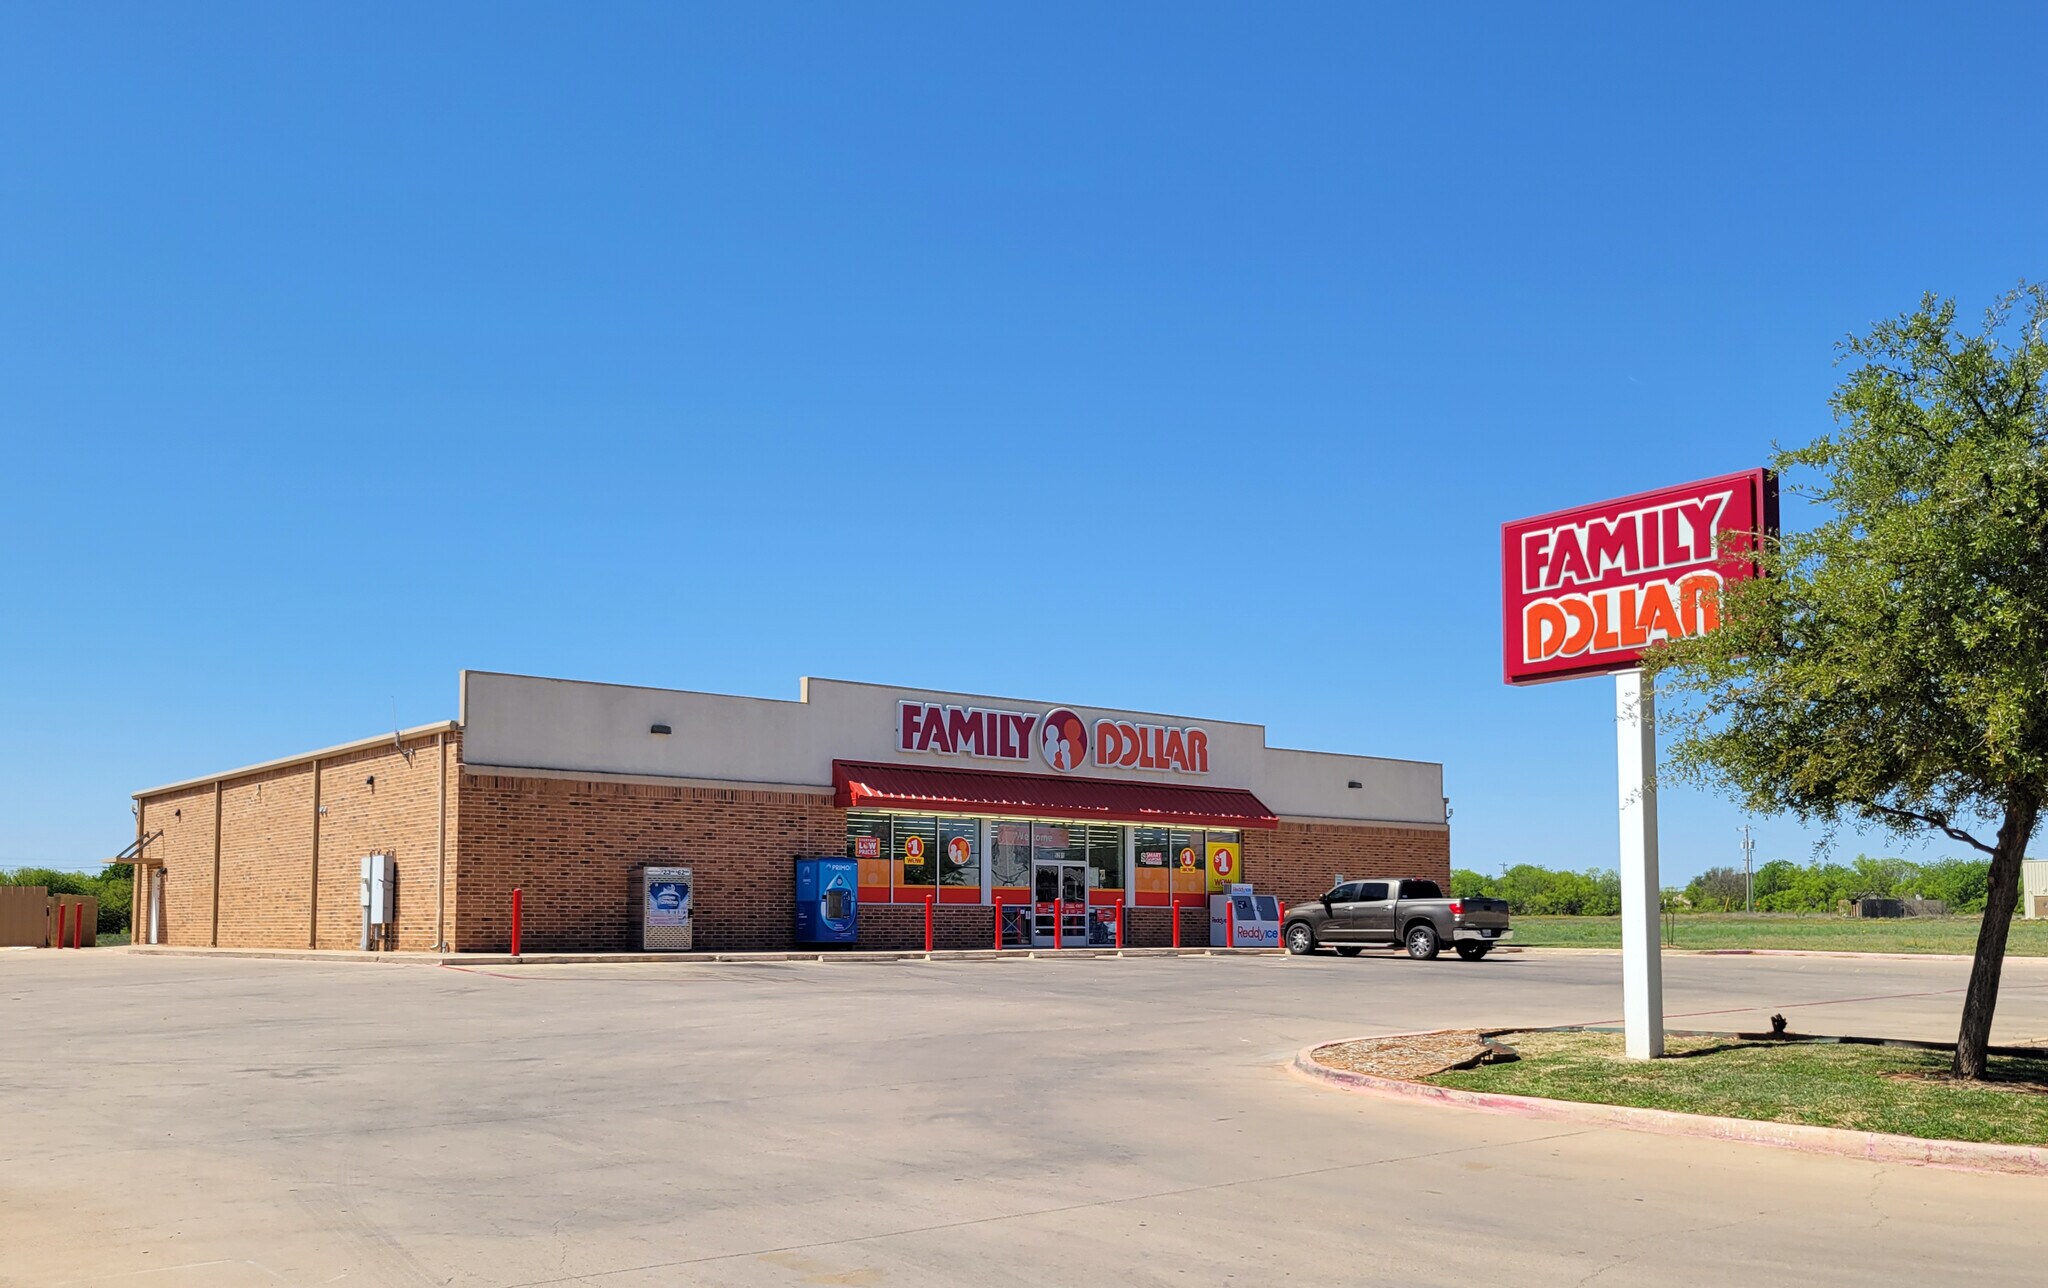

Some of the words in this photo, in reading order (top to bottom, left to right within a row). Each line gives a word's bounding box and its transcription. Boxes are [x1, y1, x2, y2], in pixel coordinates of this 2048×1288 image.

[1522, 491, 1732, 594] FAMILY
[1523, 570, 1724, 663] DOLLAR
[900, 703, 1039, 760] FAMILY
[1095, 720, 1209, 773] DOLLAR
[858, 841, 877, 850] LOW
[1016, 832, 1053, 842] Weome
[908, 840, 920, 855] $1
[1183, 851, 1191, 865] $1
[1214, 850, 1229, 872] $1
